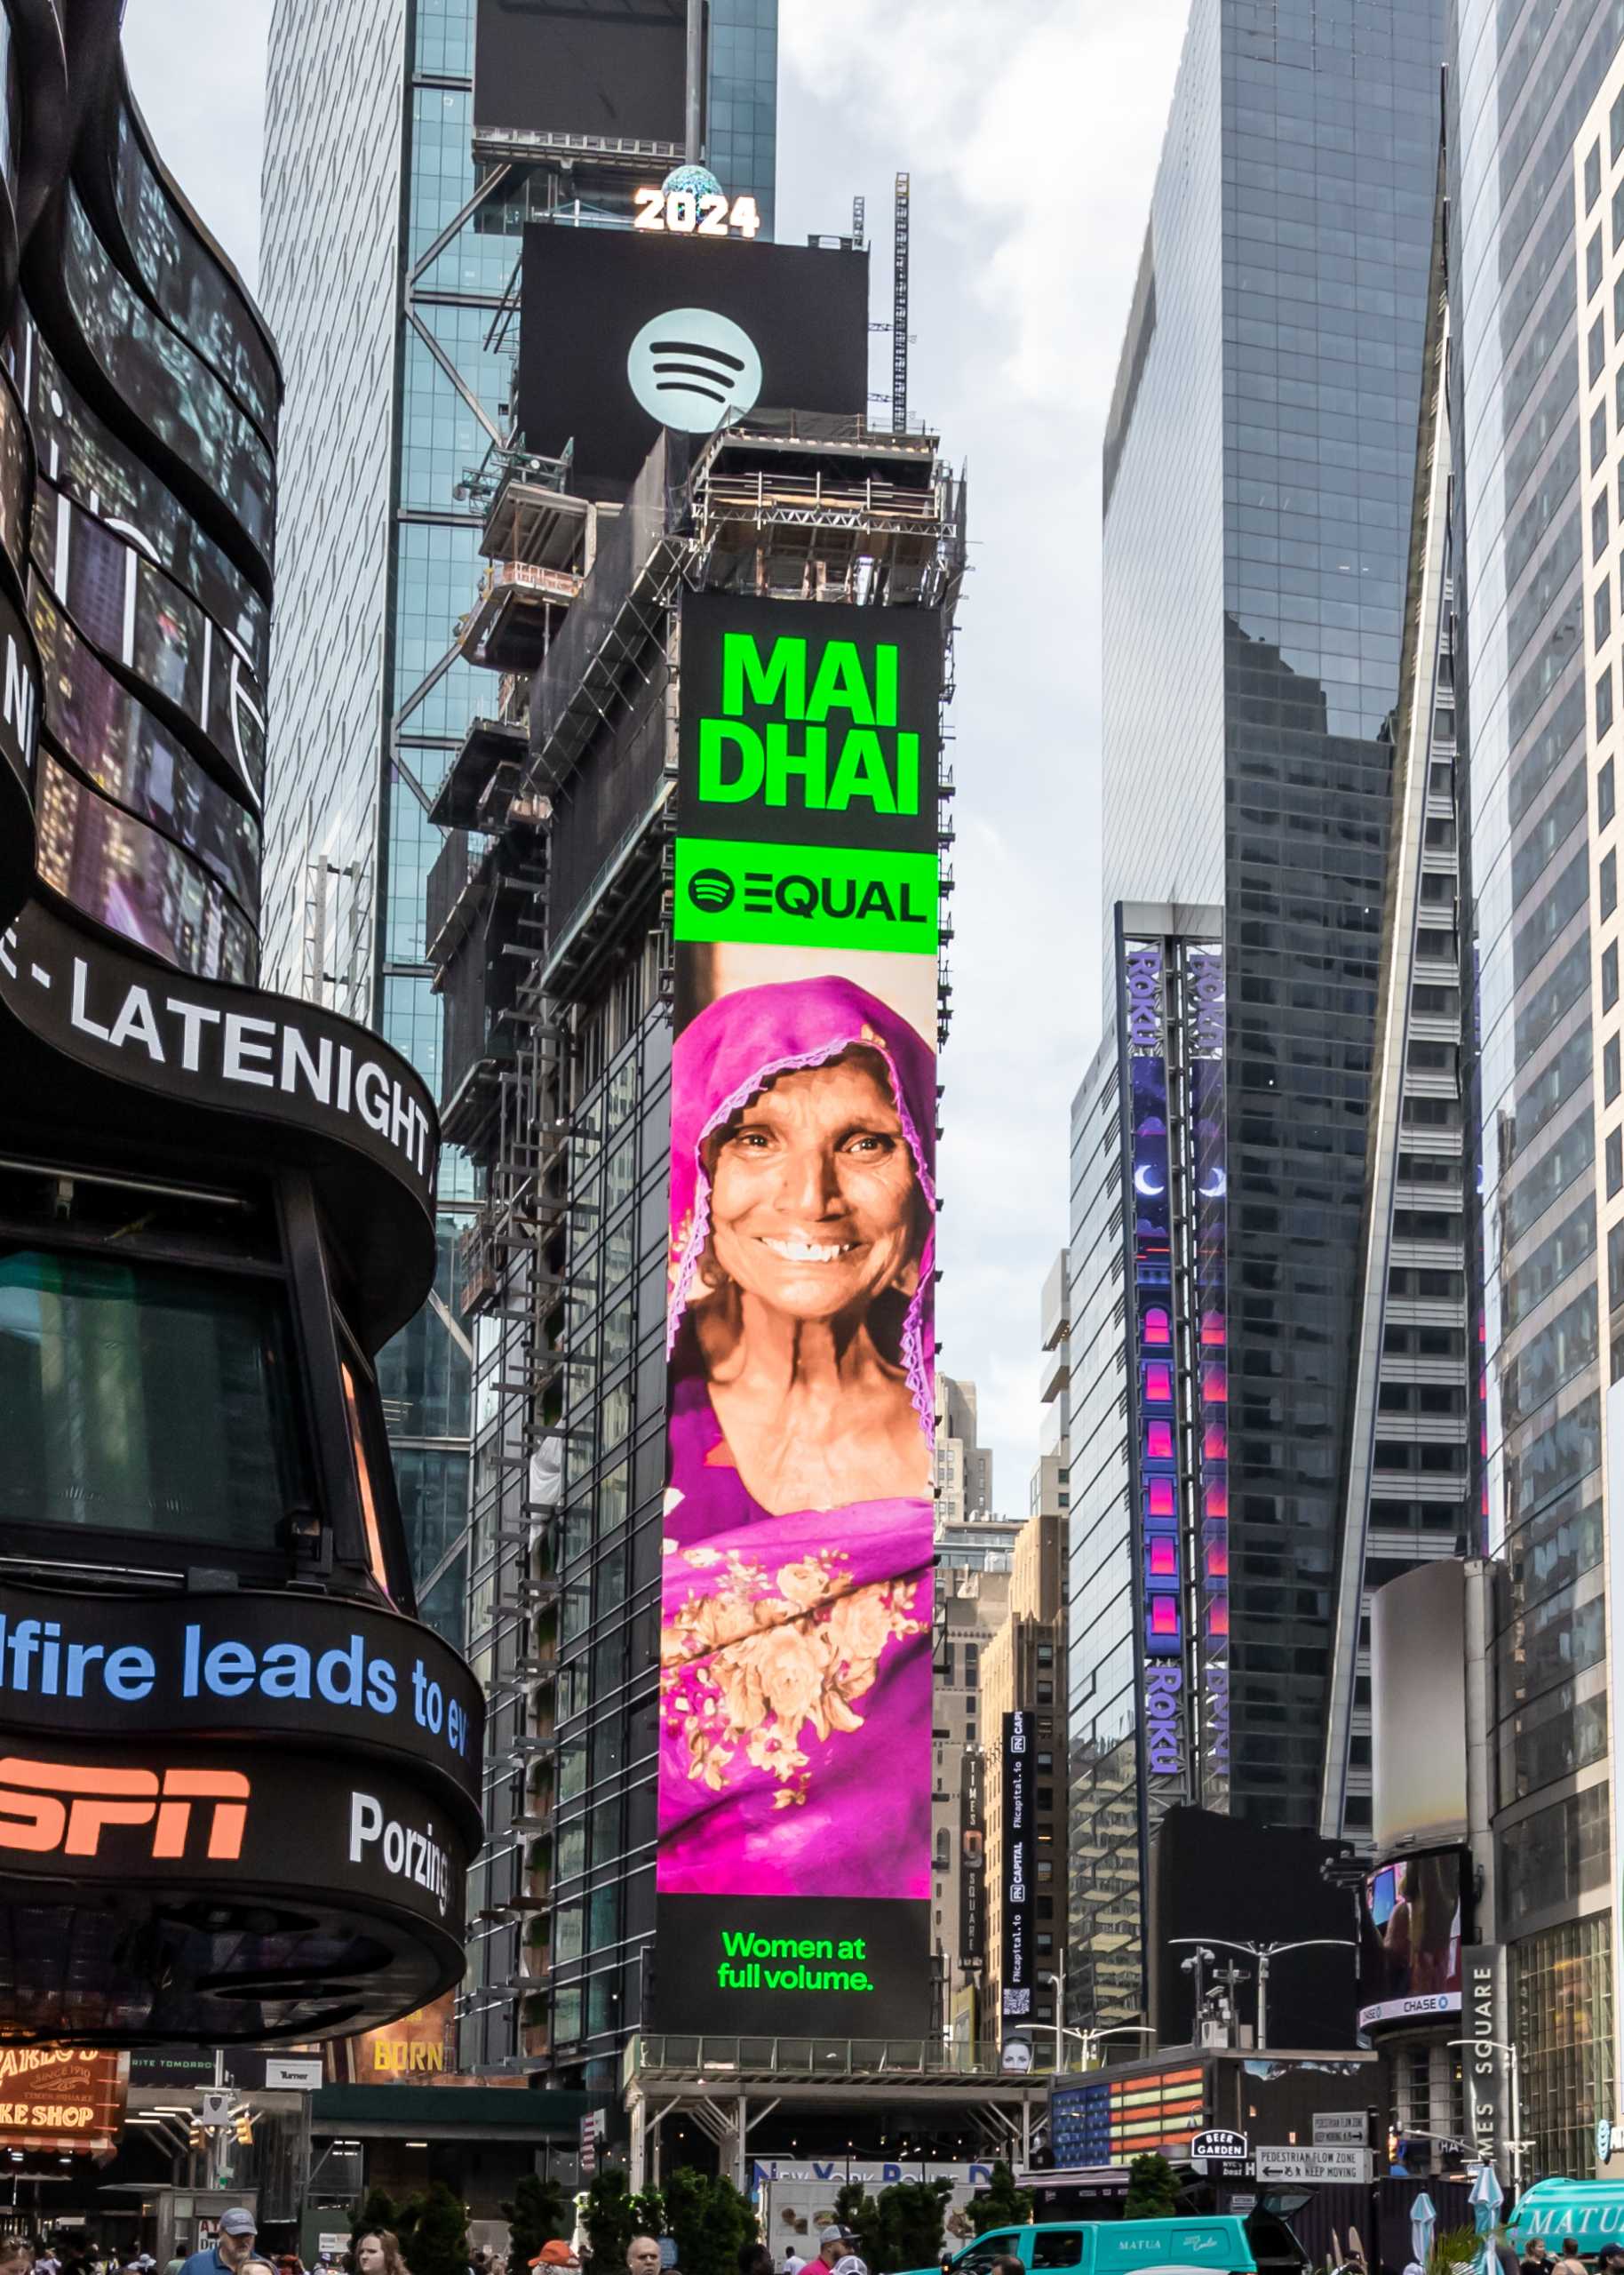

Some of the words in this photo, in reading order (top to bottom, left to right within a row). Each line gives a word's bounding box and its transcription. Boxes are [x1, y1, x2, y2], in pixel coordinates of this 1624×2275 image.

[633, 187, 760, 238] 2024
[722, 632, 898, 728] MAI
[698, 717, 919, 816] DHAI
[744, 871, 927, 924] EQUAL
[70, 956, 430, 1177] LATENIGHT
[183, 1624, 398, 1714] leads
[412, 1658, 442, 1735] to
[1146, 1667, 1182, 1774] ROKU
[1013, 1761, 1023, 1828] FNcapital.io
[1013, 1841, 1023, 1883] CAPITAL
[722, 1932, 832, 1959] Women
[838, 1938, 865, 1960] at
[1012, 1914, 1022, 1984] FNcapital.io
[718, 1962, 760, 1988] full
[764, 1965, 873, 1991] volume.
[1404, 1999, 1437, 2013] CHASE
[1473, 1968, 1493, 2074] SQUARE
[374, 2040, 443, 2071] BORN
[280, 2071, 308, 2080] Turner
[32, 2106, 94, 2127] SHOP
[1197, 2145, 1242, 2155] GARDEN
[1206, 2133, 1233, 2143] BEER
[1262, 2151, 1310, 2162] PEDESTRIAN
[1312, 2152, 1333, 2162] FLOW
[1336, 2152, 1356, 2163] ZONE
[1305, 2167, 1325, 2176] KEEP
[1327, 2167, 1357, 2177] MOVING
[1526, 2207, 1624, 2235] MATU
[1118, 2240, 1161, 2250] MATUA
